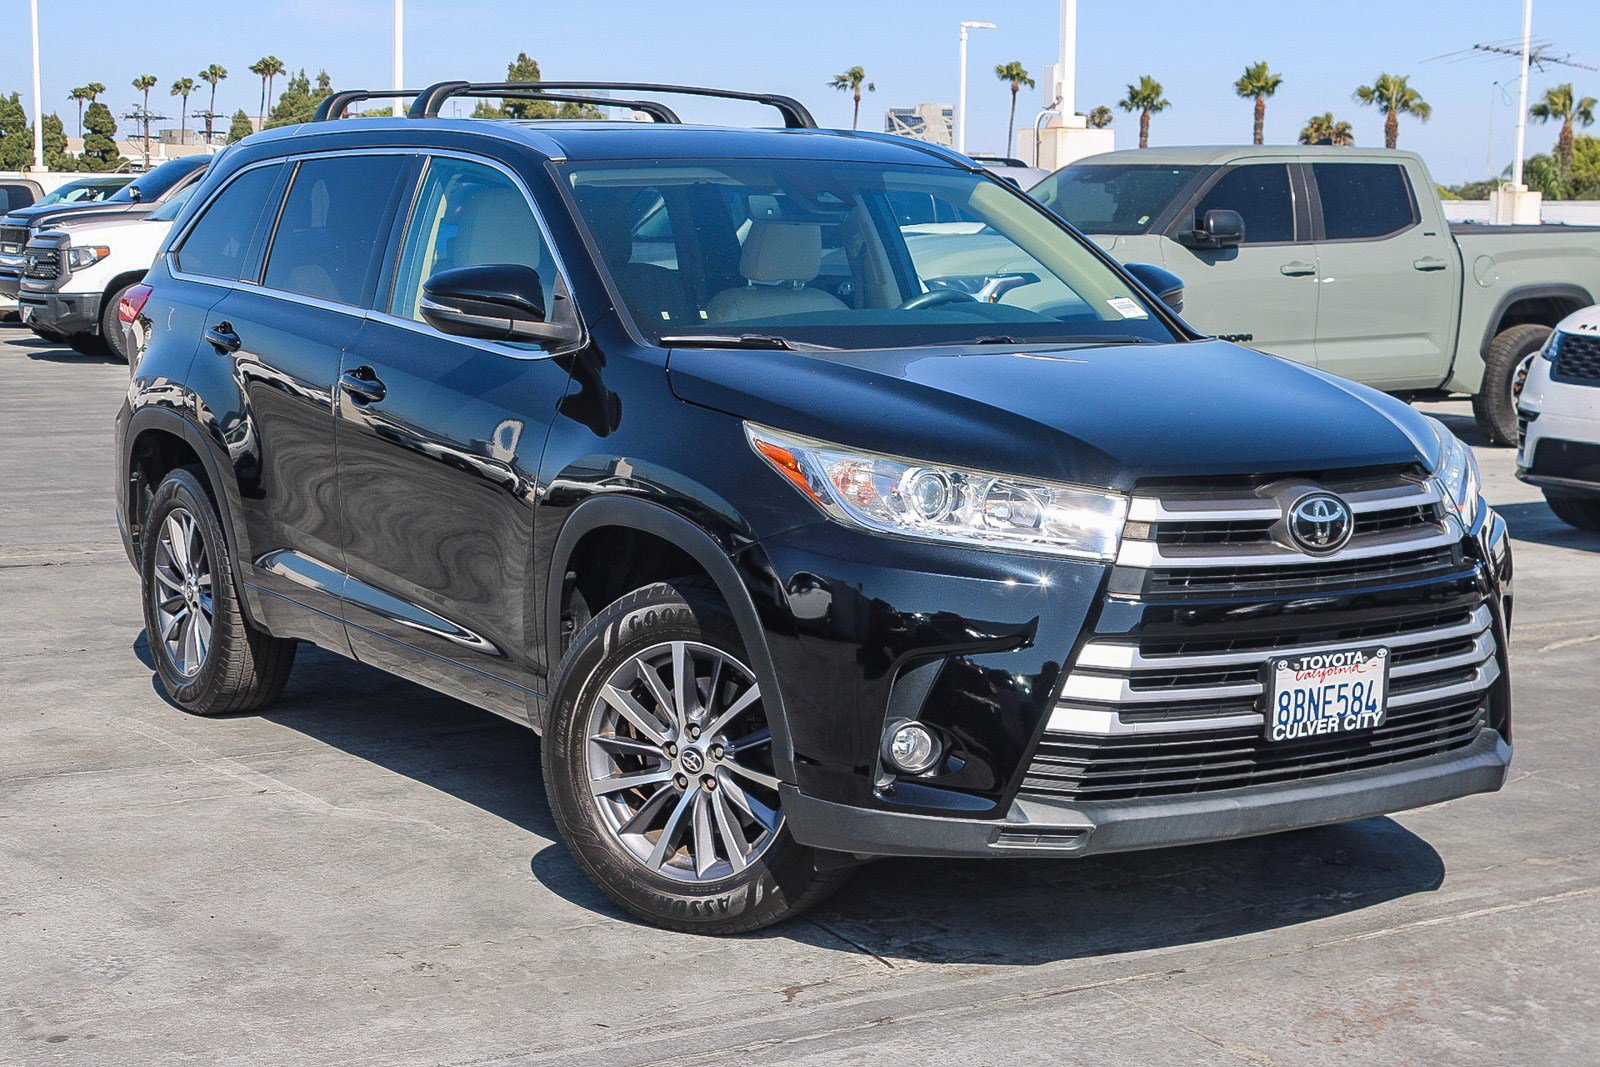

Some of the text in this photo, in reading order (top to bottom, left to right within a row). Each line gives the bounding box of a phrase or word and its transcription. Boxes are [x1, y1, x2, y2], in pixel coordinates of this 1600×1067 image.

[1295, 663, 1367, 684] California
[1300, 651, 1364, 670] TOYOTA
[1278, 680, 1377, 725] 8BNE584
[1272, 710, 1384, 741] CULVER CITY
